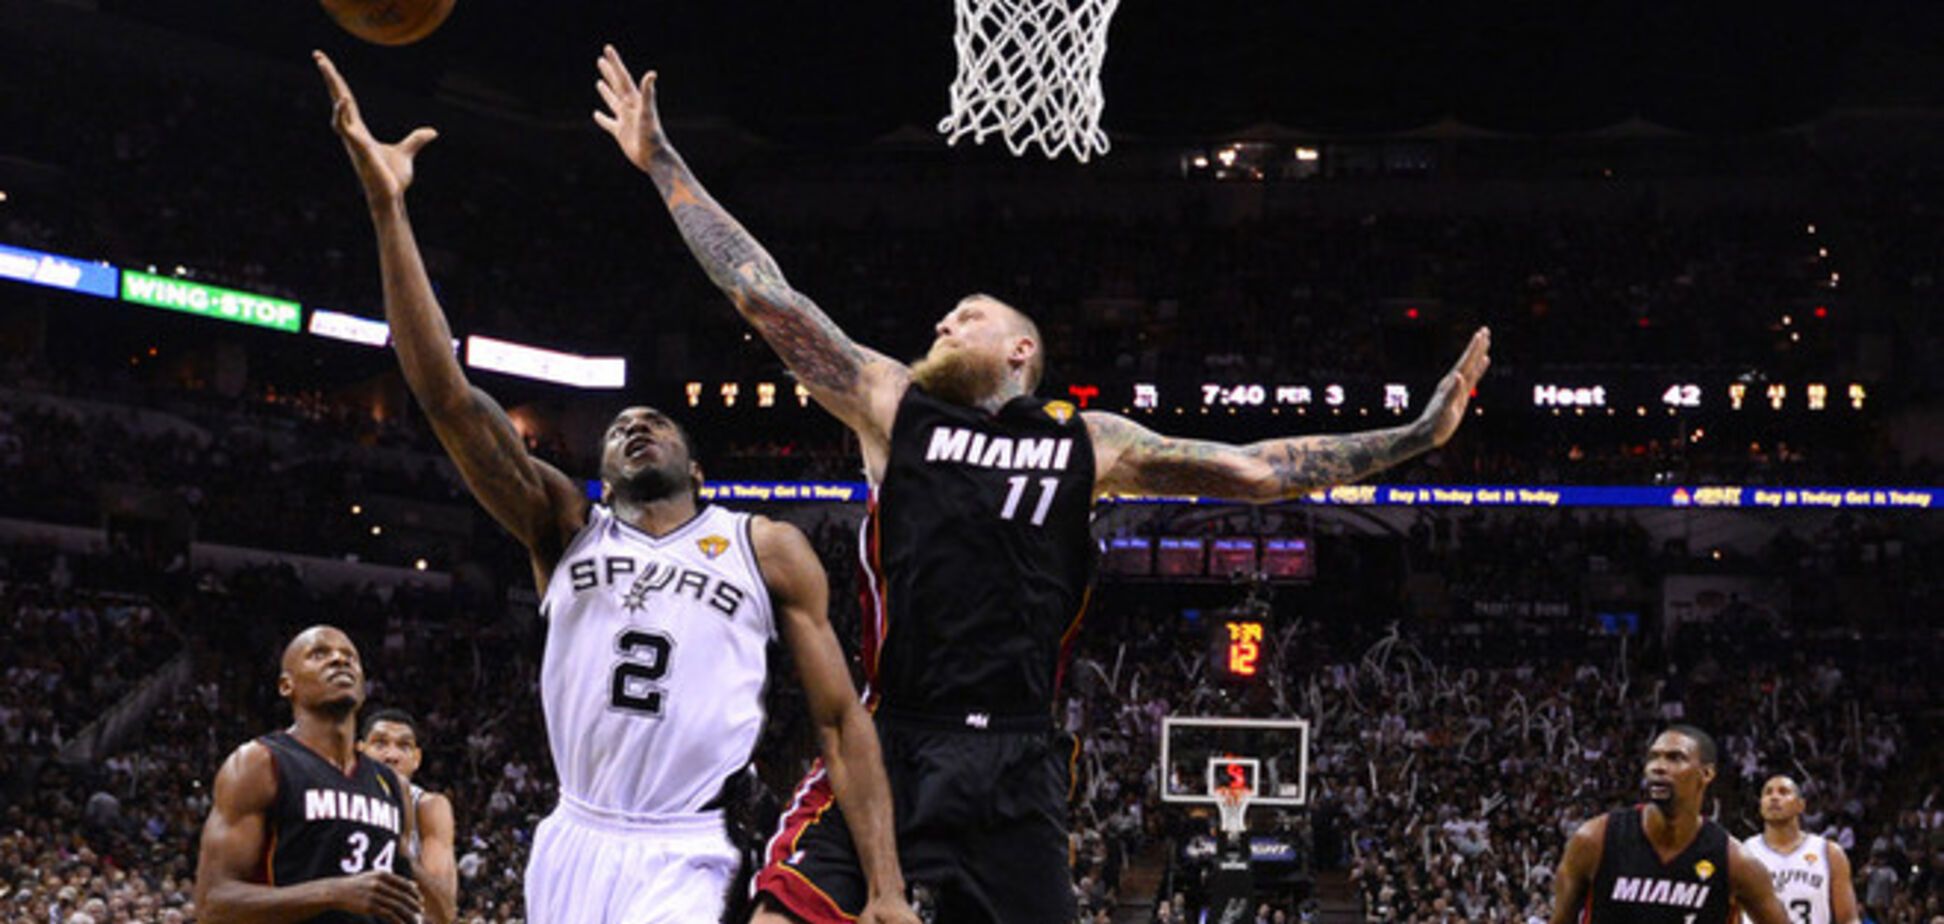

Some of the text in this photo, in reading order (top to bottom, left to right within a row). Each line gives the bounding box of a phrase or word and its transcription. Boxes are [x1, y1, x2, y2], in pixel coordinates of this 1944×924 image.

[1201, 385, 1344, 405] 7:40 PER 3
[1534, 385, 1701, 406] Heat 42
[925, 426, 1073, 470] MIAMI
[1001, 475, 1060, 526] 11
[570, 556, 744, 617] SPURS
[609, 628, 674, 718] 2
[1230, 644, 1259, 675] 12
[305, 788, 399, 834] MIAMI
[340, 830, 396, 874] 34
[1612, 877, 1710, 909] MIAMI
